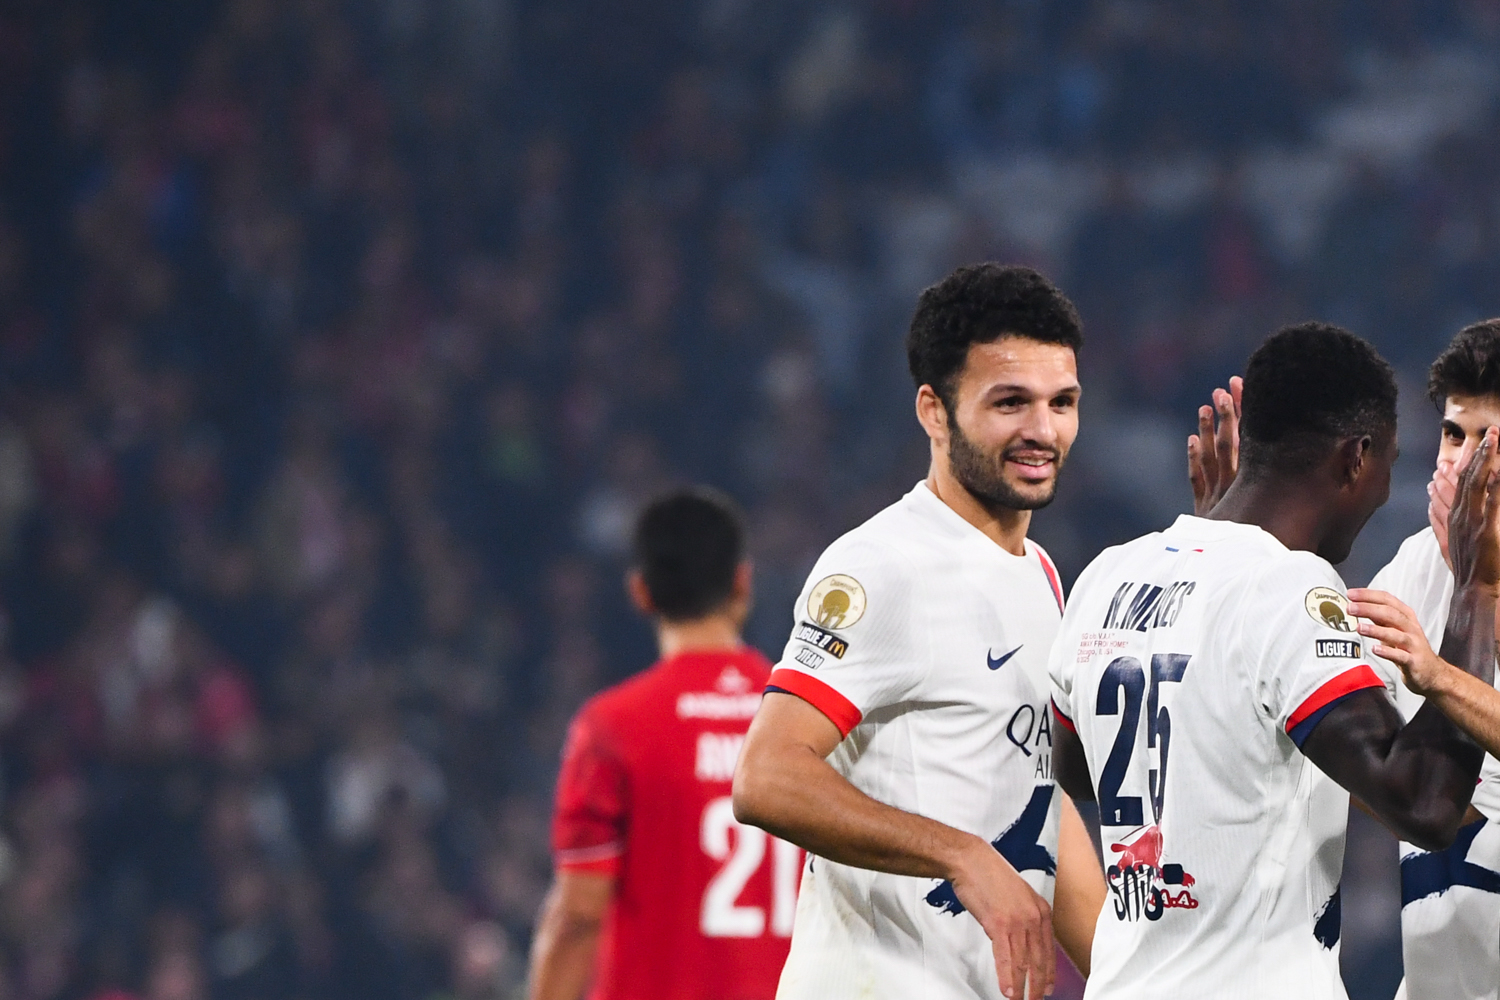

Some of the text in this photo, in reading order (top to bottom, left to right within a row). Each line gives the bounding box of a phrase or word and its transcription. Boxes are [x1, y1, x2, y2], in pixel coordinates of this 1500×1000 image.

[1317, 642, 1346, 657] LIGUE
[1095, 653, 1192, 826] 25
[701, 796, 800, 937] 21
